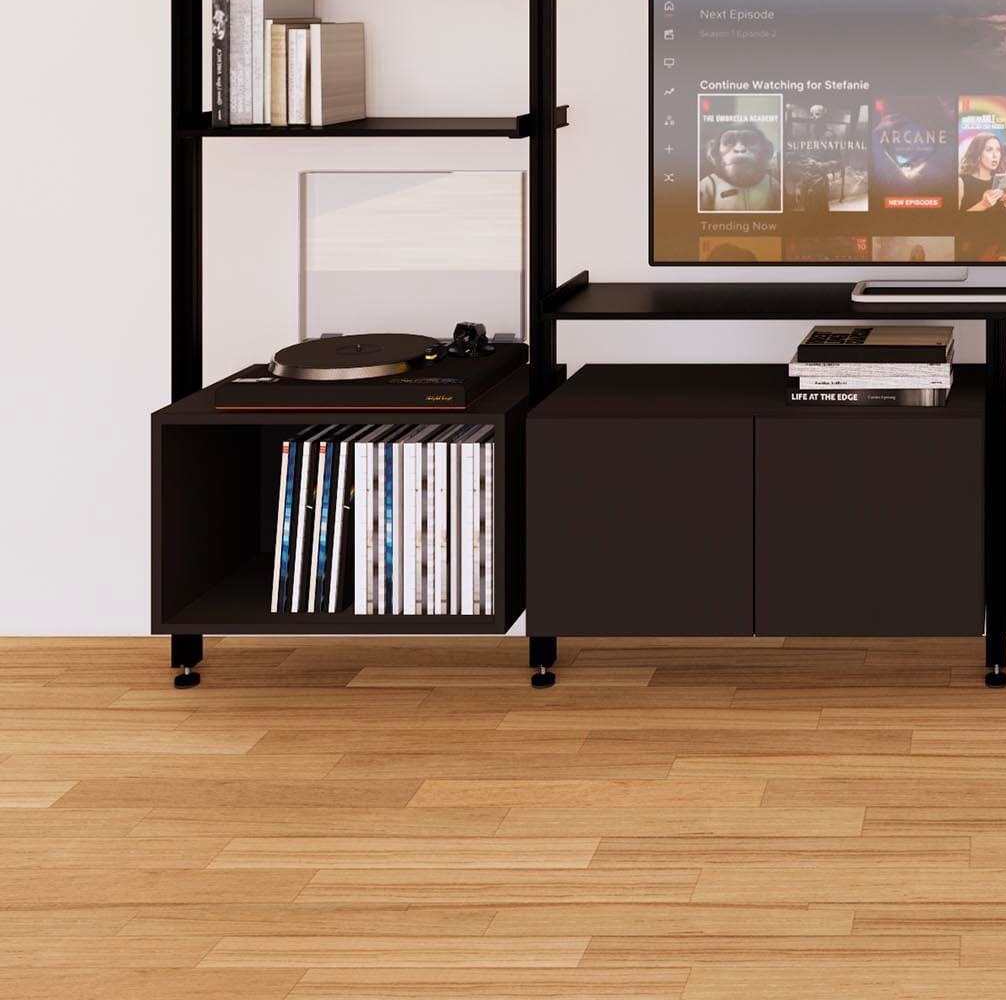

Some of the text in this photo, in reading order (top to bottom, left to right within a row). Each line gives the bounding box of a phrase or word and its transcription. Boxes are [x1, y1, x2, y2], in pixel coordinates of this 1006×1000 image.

[700, 9, 775, 22] Next Episode
[700, 80, 870, 93] Continue Watching for Stefanie
[880, 130, 947, 144] ARCANE
[786, 141, 868, 150] SUPERNATURAL
[700, 222, 777, 233] Trending Now
[791, 393, 808, 401] LIFE
[809, 393, 819, 401] AT
[820, 393, 836, 401] THE
[837, 393, 858, 401] EDGE
